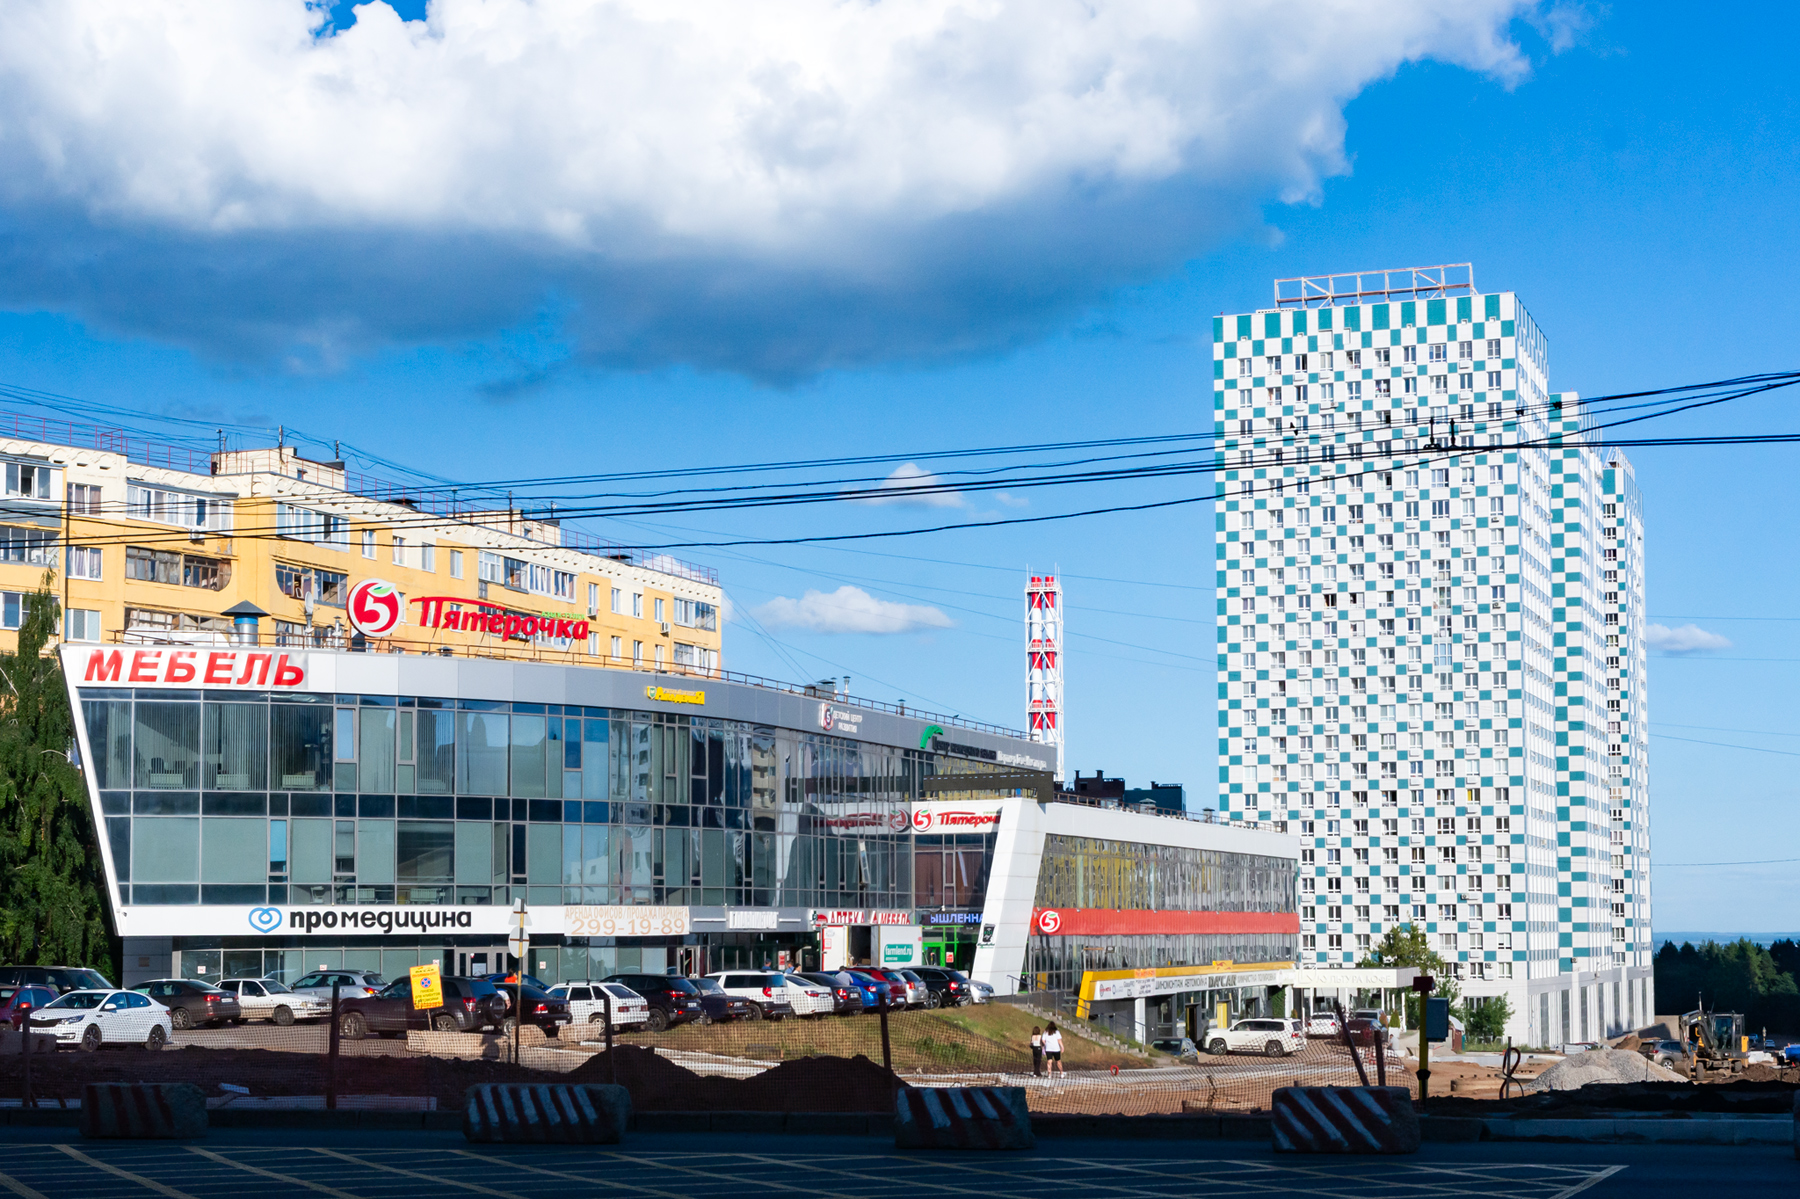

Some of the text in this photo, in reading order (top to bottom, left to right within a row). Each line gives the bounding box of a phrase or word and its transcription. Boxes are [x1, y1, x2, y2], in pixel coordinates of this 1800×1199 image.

[84, 649, 304, 686] МЕБЕЛЬ
[565, 907, 592, 919] АРЕНДА
[829, 911, 865, 924] АПТЕКА
[571, 919, 685, 935] 299-19-89
